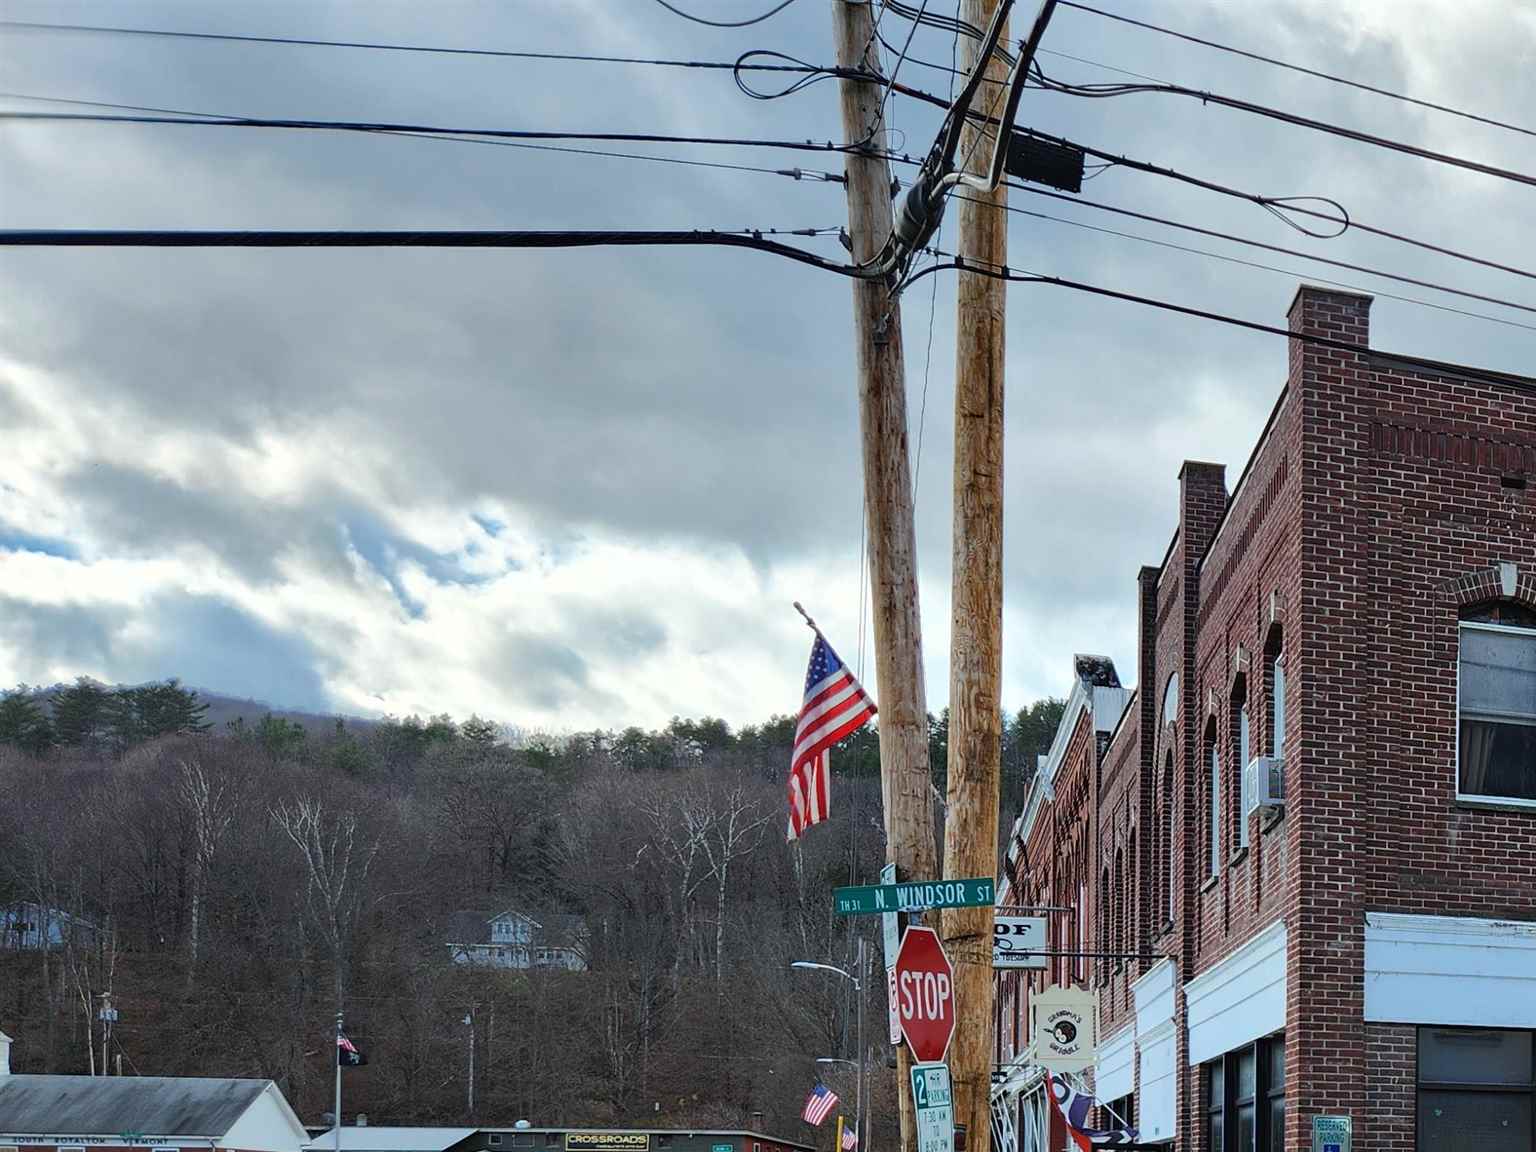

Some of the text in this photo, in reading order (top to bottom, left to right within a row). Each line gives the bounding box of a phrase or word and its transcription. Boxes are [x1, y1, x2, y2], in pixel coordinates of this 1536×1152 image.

[840, 883, 990, 911] TH 31 N. WINDSOR ST
[900, 970, 950, 1020] STOP
[915, 1074, 926, 1104] 2
[1317, 1119, 1347, 1131] RESERVED
[12, 1136, 169, 1145] SOUTH ROYALTON VERMONT
[568, 1135, 647, 1144] CROSSROADS
[1319, 1131, 1345, 1144] PARKING
